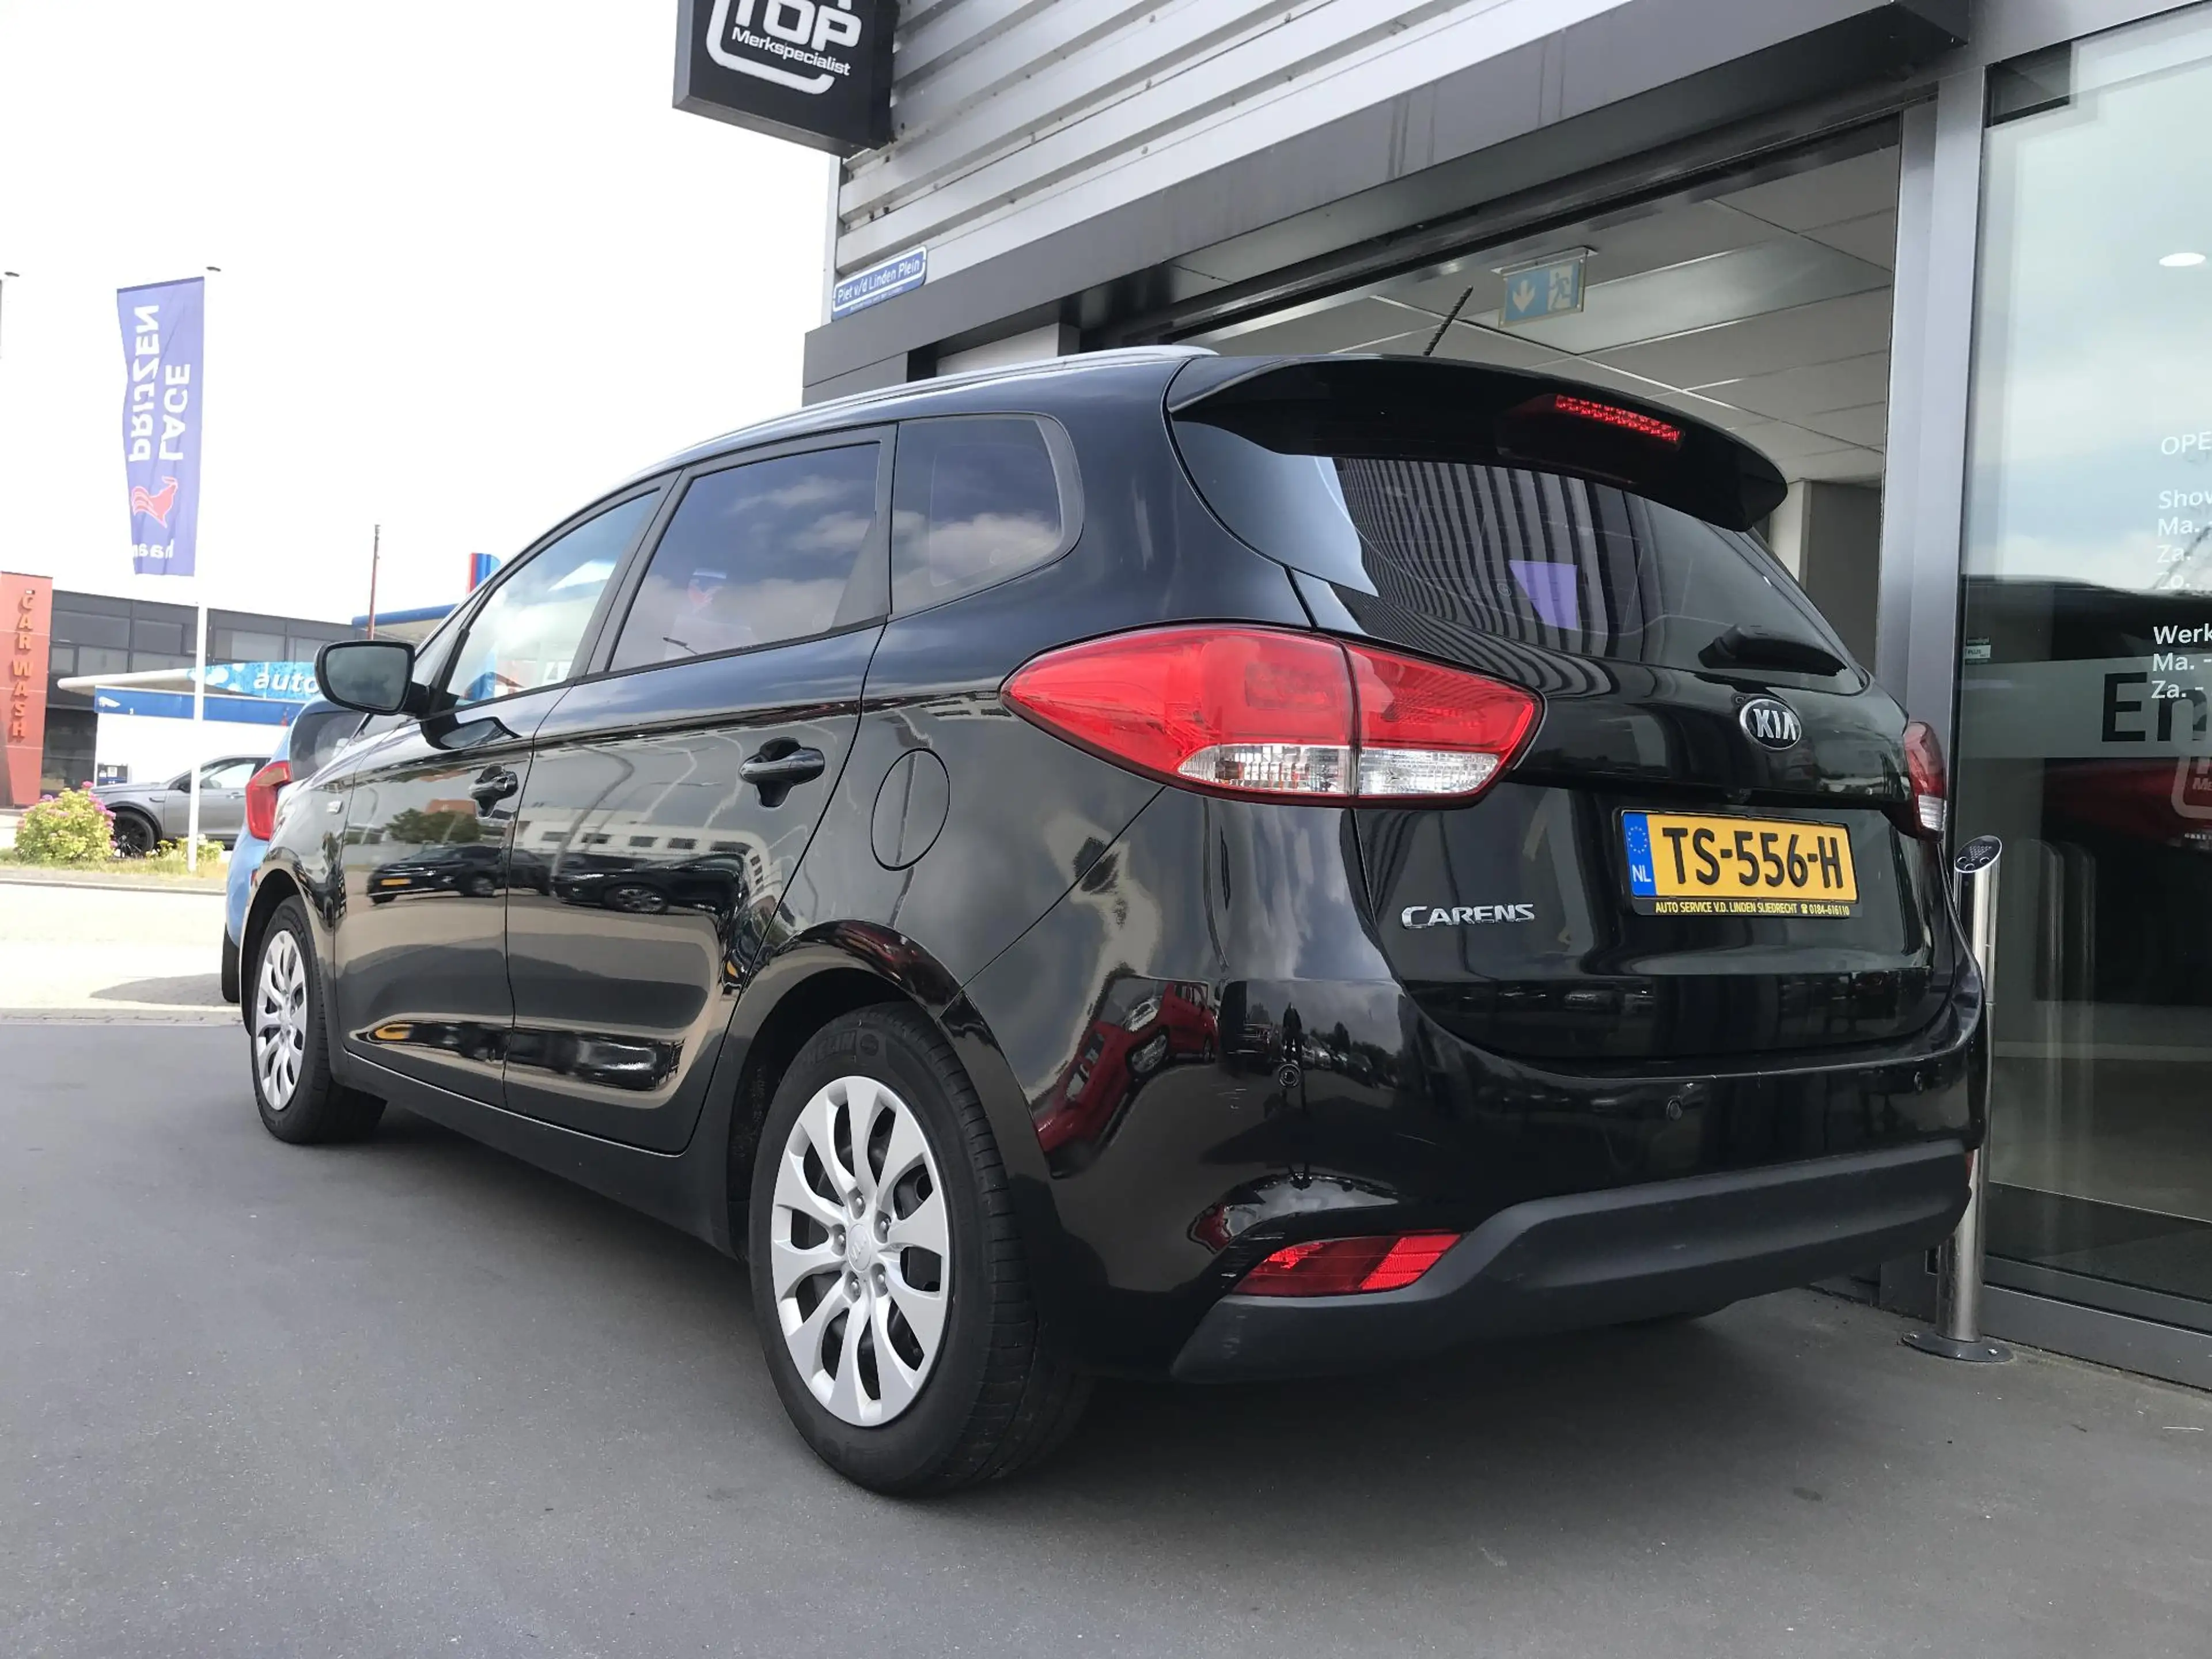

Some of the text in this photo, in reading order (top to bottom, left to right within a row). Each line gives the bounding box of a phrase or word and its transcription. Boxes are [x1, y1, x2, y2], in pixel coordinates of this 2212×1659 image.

[732, 26, 851, 75] Merkspecialist
[838, 285, 853, 303] Piet
[854, 279, 868, 296] v/d
[869, 269, 897, 289] Linden
[898, 259, 920, 278] Plein
[2157, 517, 2200, 536] Ma.
[2157, 544, 2191, 563] Za.
[12, 594, 33, 736] CAR WASH
[2153, 653, 2195, 672] Ma.
[2151, 680, 2187, 699] Za.
[1753, 709, 1796, 740] KIA
[1662, 827, 1843, 888] TS-556-H
[1632, 865, 1652, 882] NL
[1656, 902, 1679, 913] AUTO
[1680, 902, 1713, 913] SERVICE
[1714, 902, 1729, 913] V.D.
[1730, 902, 1756, 913] LINDEN
[1758, 903, 1797, 914] SLIEDRECHT
